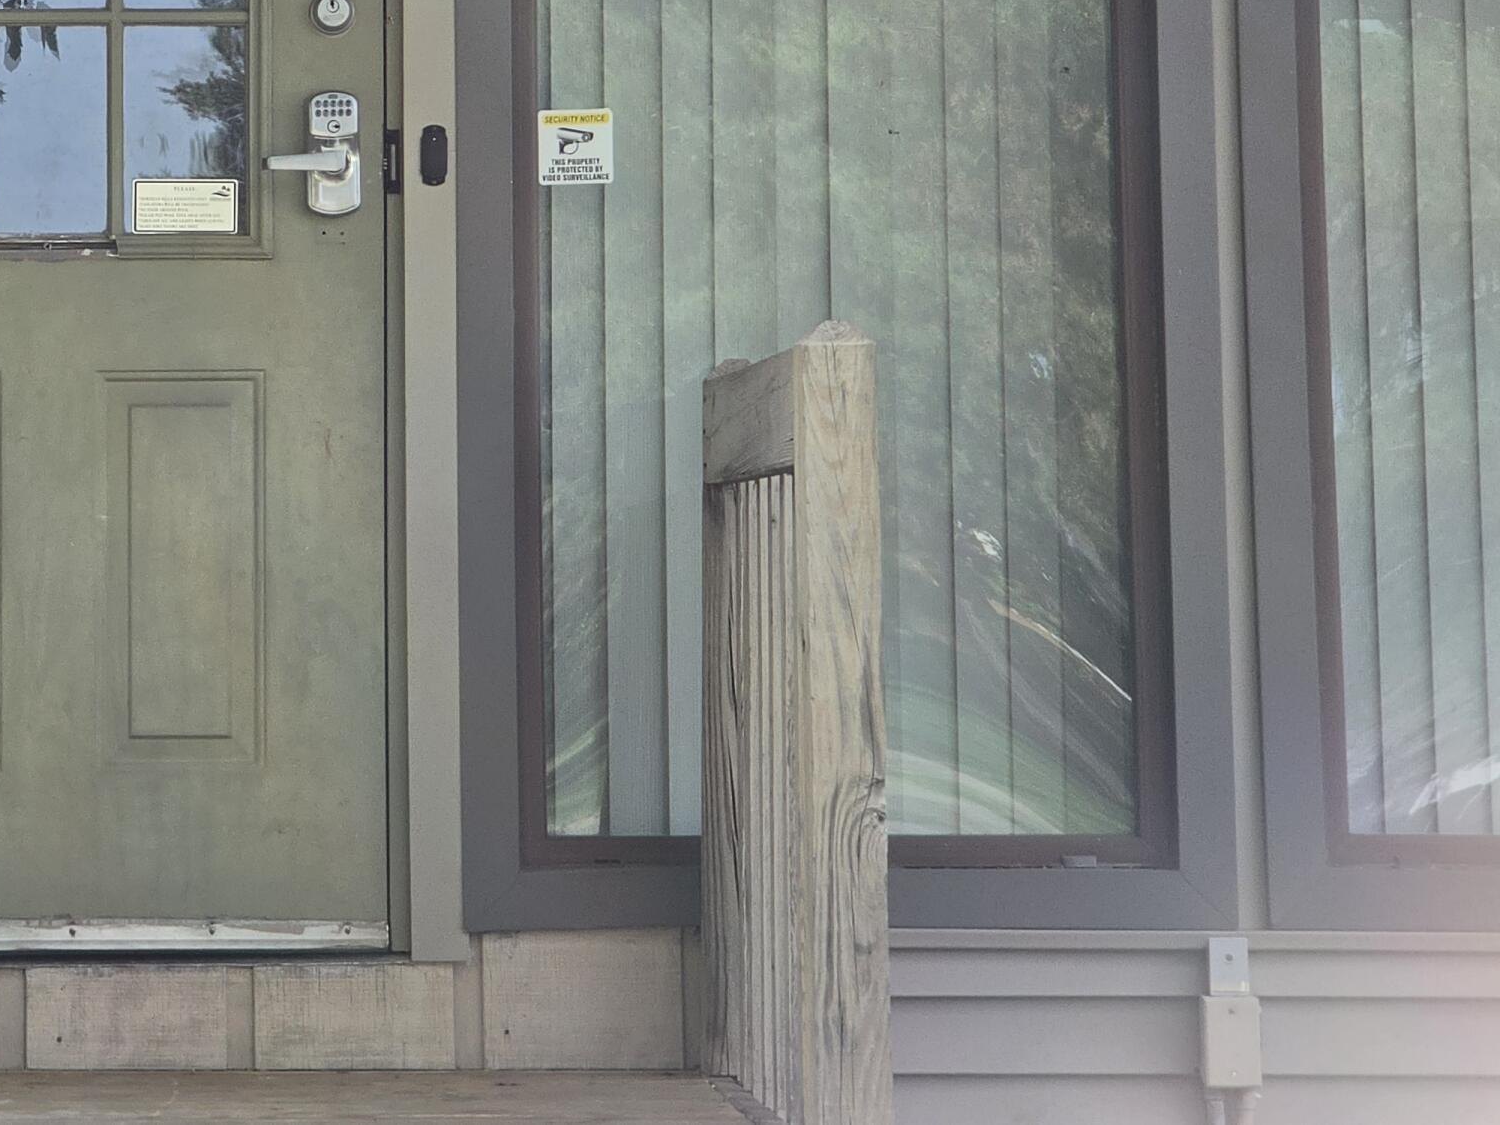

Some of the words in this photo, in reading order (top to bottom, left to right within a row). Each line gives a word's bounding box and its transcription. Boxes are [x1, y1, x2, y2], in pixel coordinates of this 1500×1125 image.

[580, 115, 604, 123] NOTICE
[567, 157, 600, 165] PROPERTY
[557, 165, 594, 173] PROTECTED
[563, 173, 610, 181] SURVEILLANCE
